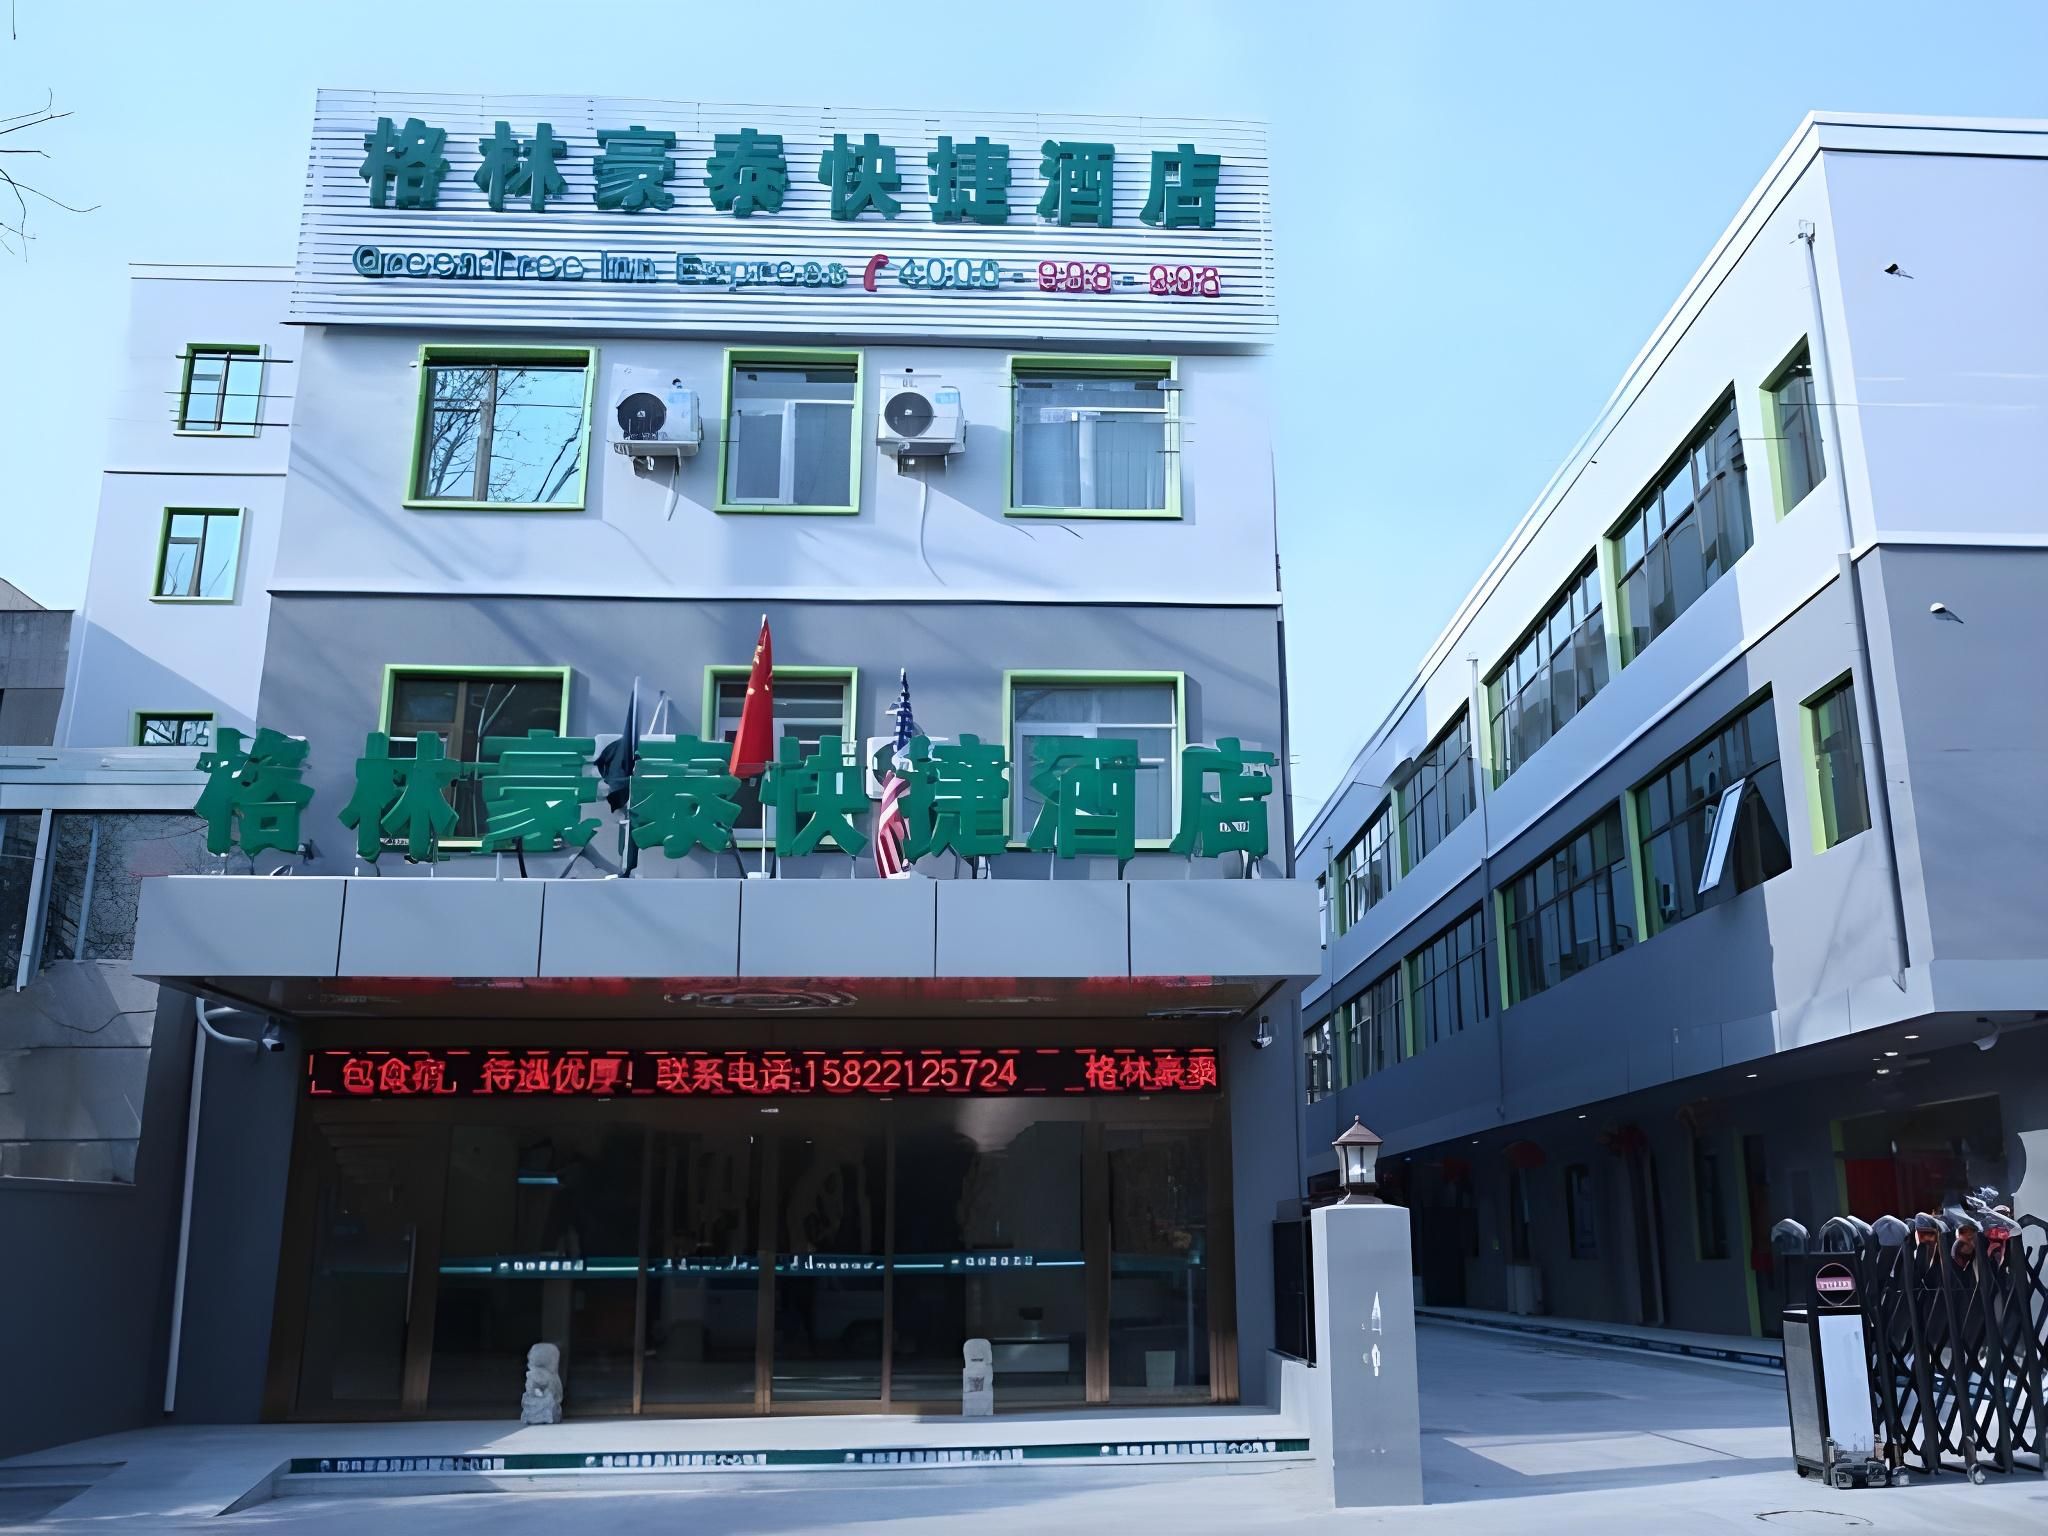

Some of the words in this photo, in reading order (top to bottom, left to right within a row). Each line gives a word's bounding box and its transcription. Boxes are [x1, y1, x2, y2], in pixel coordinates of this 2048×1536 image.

[359, 116, 1222, 228] 格林豪泰快捷酒店
[600, 250, 658, 284] Inn
[193, 726, 1278, 863] 格林豪泰快捷酒店
